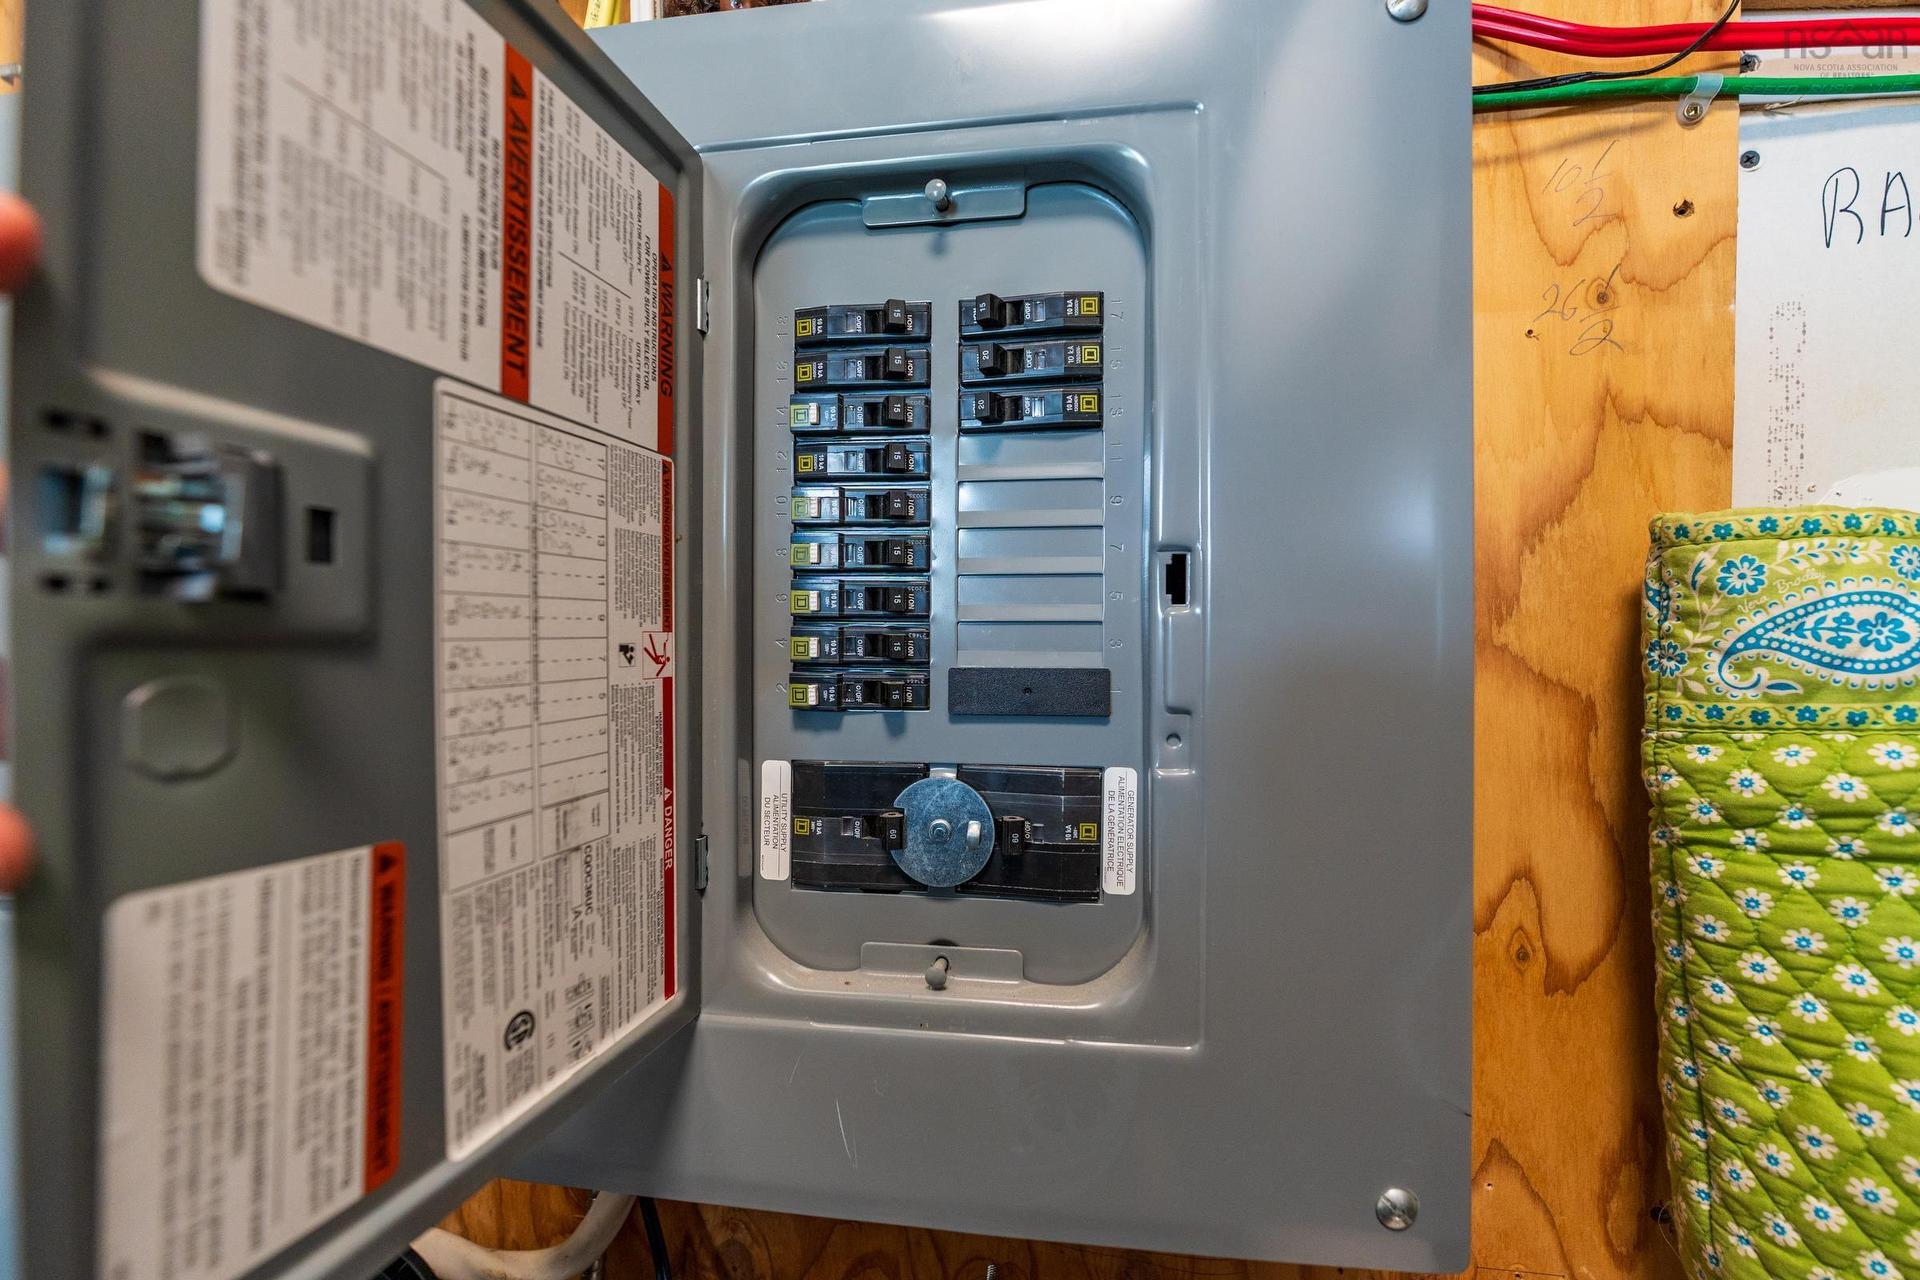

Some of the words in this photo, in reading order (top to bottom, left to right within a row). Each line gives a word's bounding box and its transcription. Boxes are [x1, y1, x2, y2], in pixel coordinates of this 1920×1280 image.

[1822, 167, 1920, 248] RA
[505, 107, 529, 379] AVERTISSEMENT
[980, 302, 986, 313] 15
[1110, 299, 1124, 321] 17
[894, 309, 901, 318] 15
[660, 280, 673, 398] WARNING
[894, 355, 902, 365] 15
[982, 349, 989, 361] 20
[894, 403, 901, 413] 15
[977, 399, 985, 410] 20
[894, 451, 902, 460] 15
[598, 457, 605, 470] 17
[598, 493, 605, 507] 15
[894, 498, 902, 508] 15
[776, 495, 788, 517] 10
[598, 534, 605, 547] 13
[894, 546, 901, 555] 15
[1110, 542, 1124, 552] 7
[598, 575, 605, 586] 11
[894, 594, 902, 604] 15
[894, 641, 901, 651] 15
[892, 689, 900, 699] 15
[1108, 790, 1115, 801] DE
[764, 797, 770, 809] DU
[1108, 803, 1115, 814] LA
[1117, 775, 1125, 834] ALIMENTATION
[665, 805, 673, 870] DANGER
[889, 829, 897, 839] 60
[1126, 842, 1134, 873] SUPPLY
